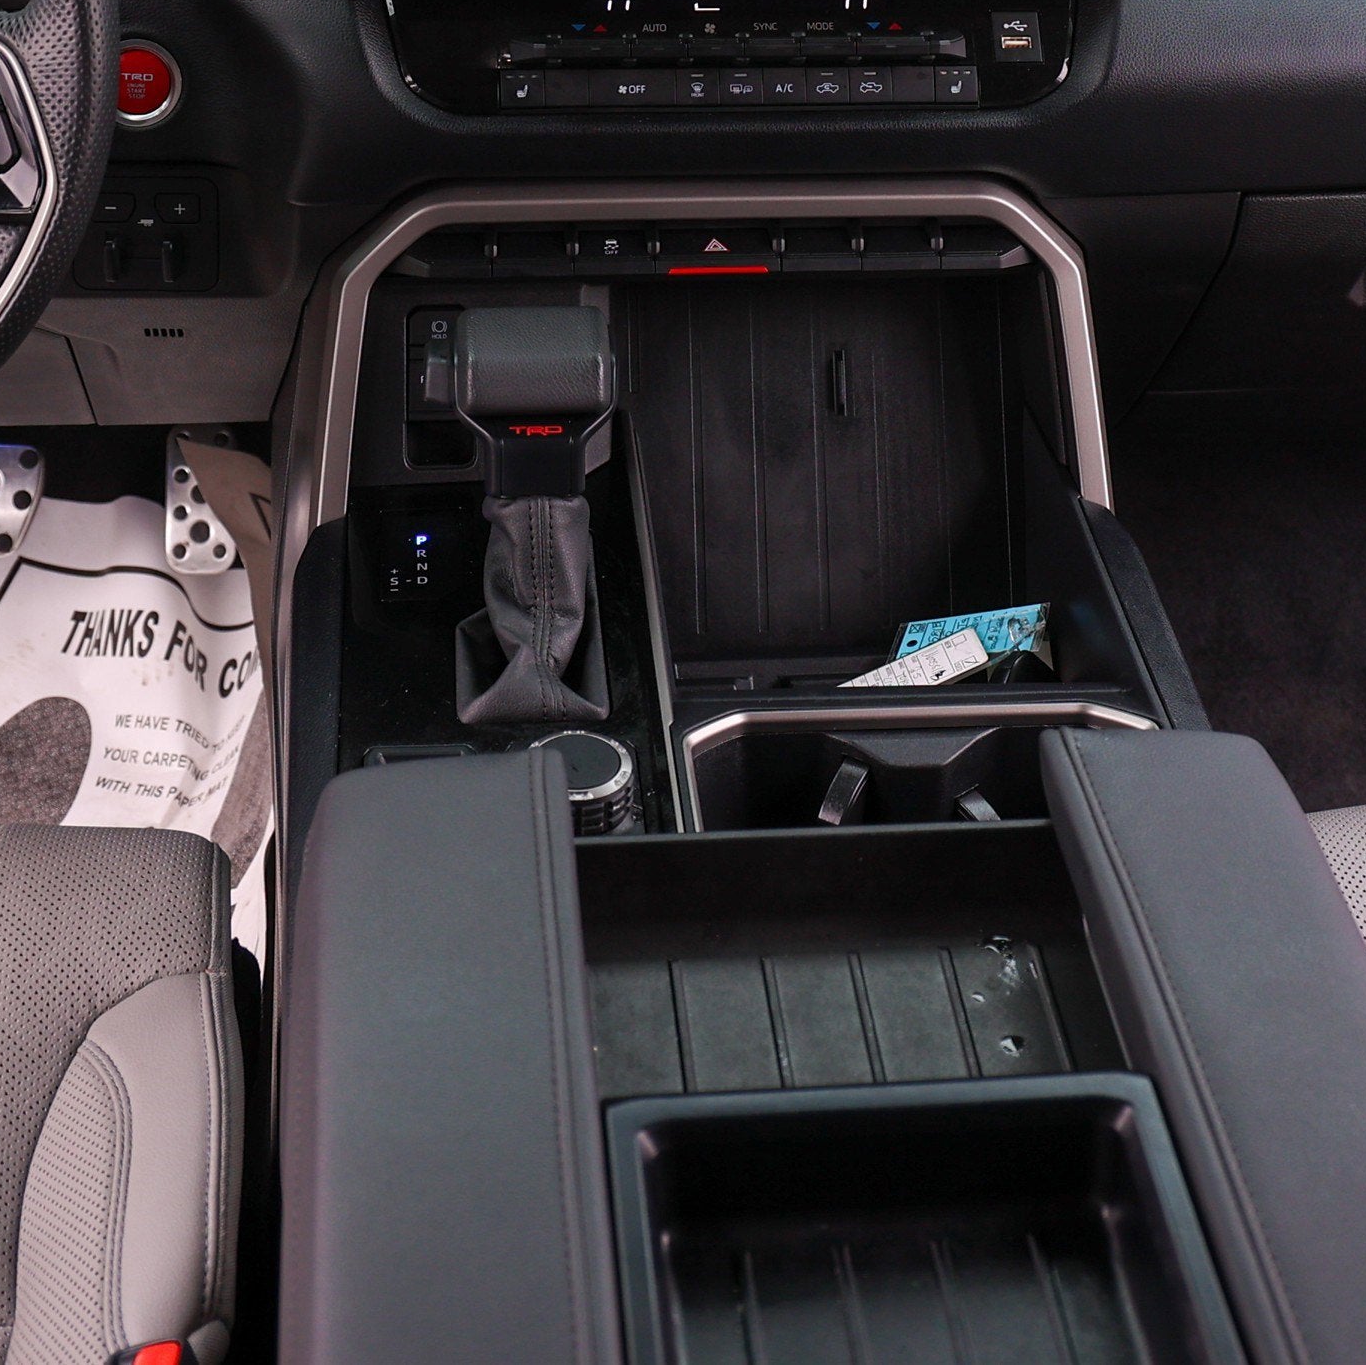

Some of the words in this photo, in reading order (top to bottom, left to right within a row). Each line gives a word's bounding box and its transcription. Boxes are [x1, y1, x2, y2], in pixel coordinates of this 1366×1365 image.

[642, 23, 668, 33] AUTO
[753, 22, 778, 31] SYNC
[806, 22, 834, 31] MODE
[121, 72, 154, 82] TRD
[627, 84, 647, 94] OFF
[775, 83, 794, 94] A/C
[508, 425, 564, 436] TRD
[415, 535, 427, 546] P
[416, 549, 427, 558] R
[416, 562, 428, 571] N
[390, 576, 399, 585] S
[417, 575, 428, 585] D
[60, 608, 160, 658] THANKS
[163, 619, 208, 693] FOR
[114, 713, 133, 728] WE
[135, 713, 170, 731] HAVE
[175, 718, 210, 750] TRIED
[103, 746, 138, 764] YOUR
[95, 775, 131, 794] WITH
[135, 782, 164, 799] THIS
[166, 786, 202, 809] PAPER
